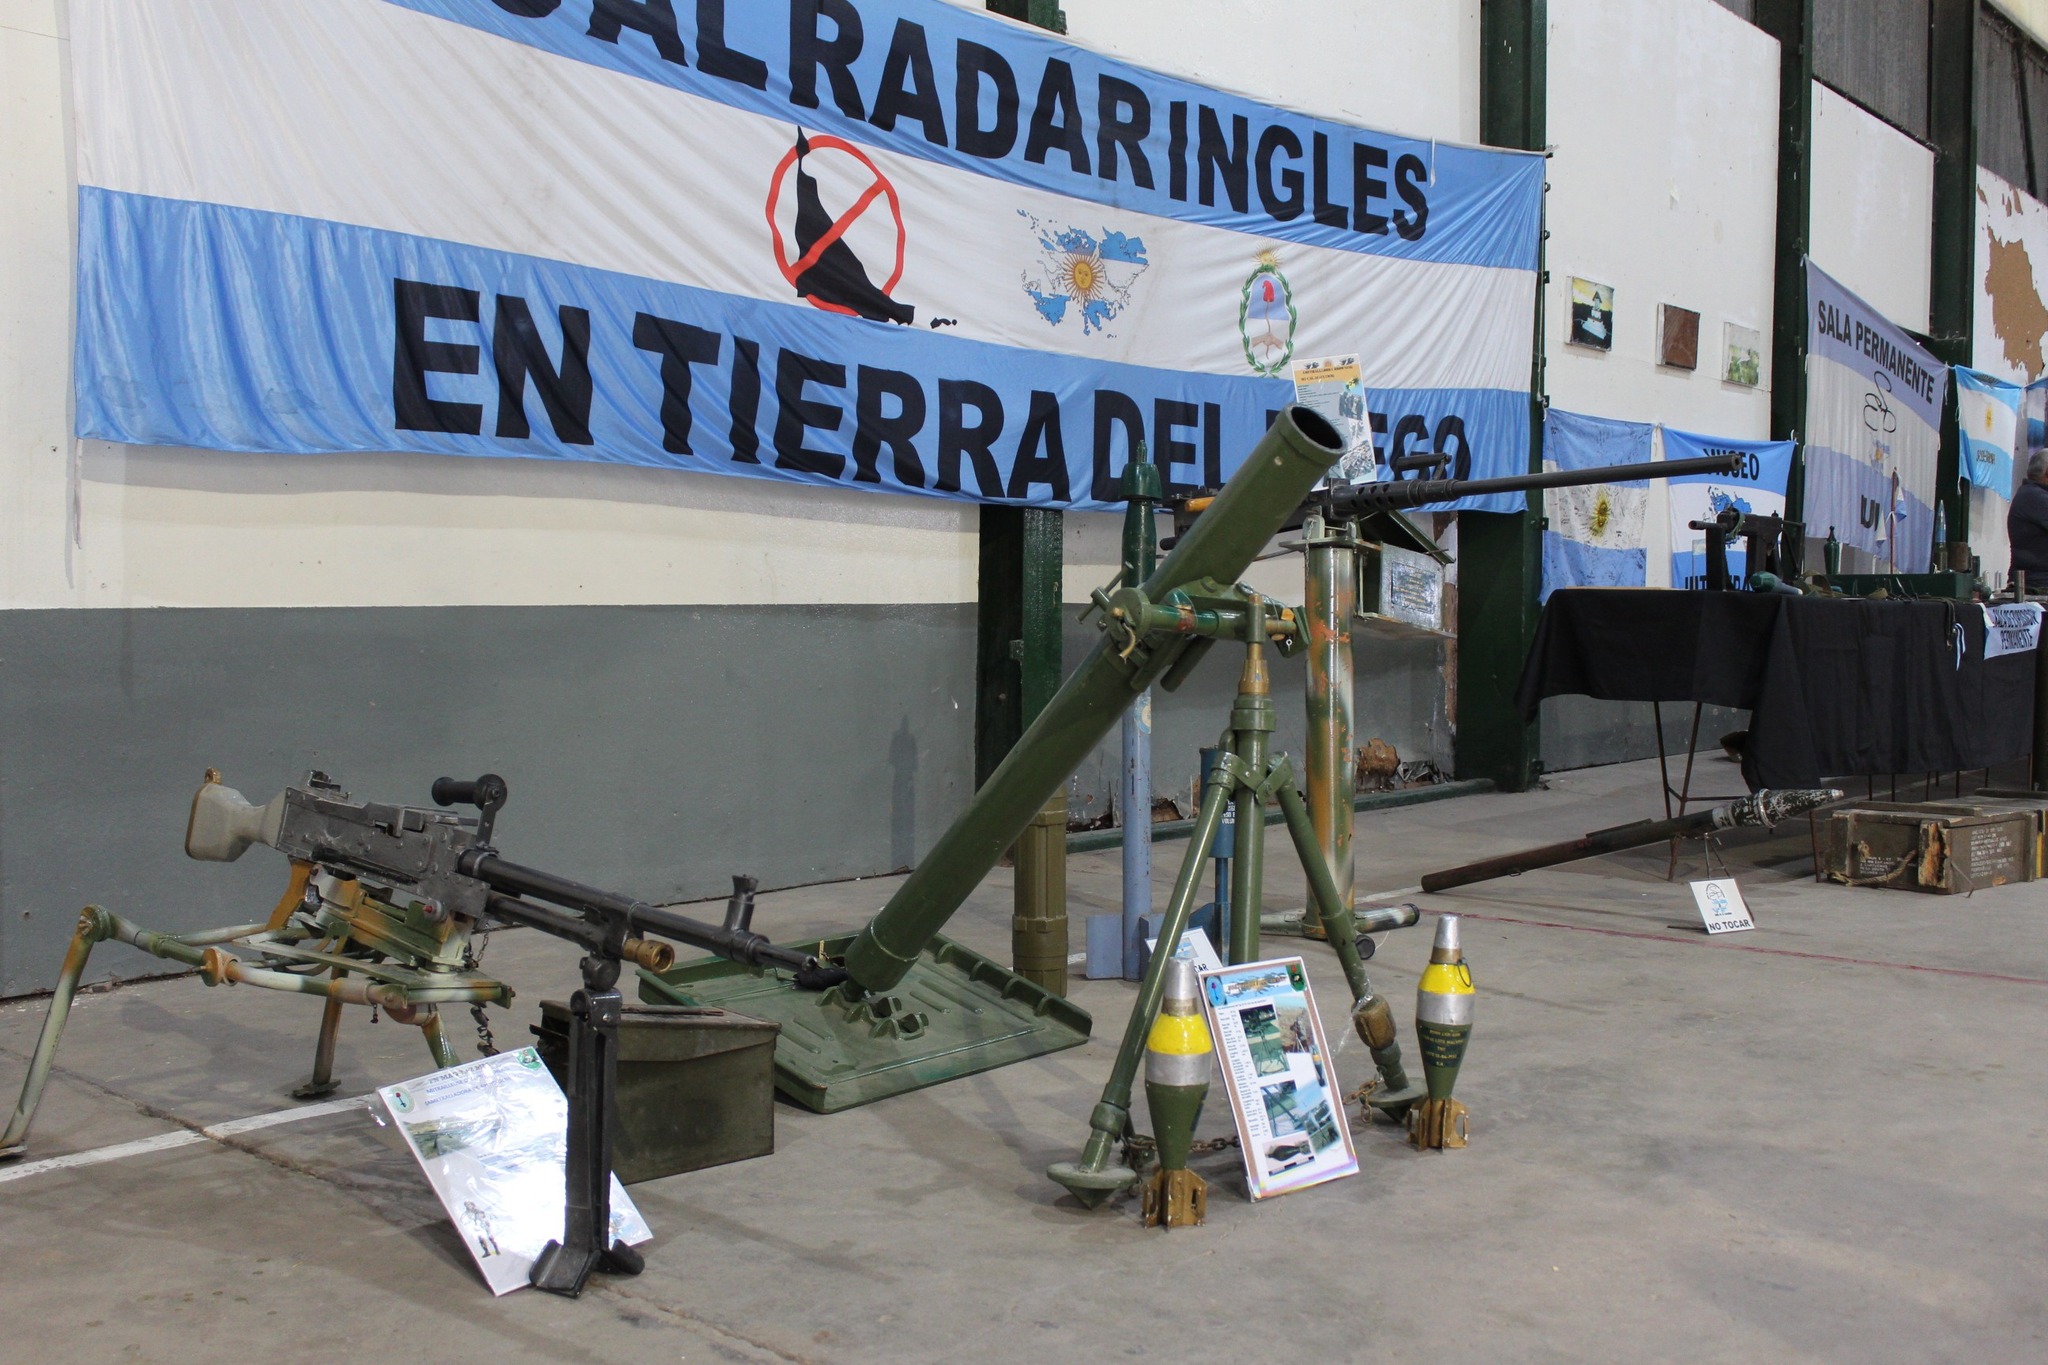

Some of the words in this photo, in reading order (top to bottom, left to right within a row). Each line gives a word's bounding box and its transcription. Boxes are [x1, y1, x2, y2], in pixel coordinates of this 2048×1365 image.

[789, 0, 1156, 189] RADAR
[1168, 101, 1428, 241] INGLES
[395, 278, 594, 446] EN
[633, 311, 1072, 502] TIERRA
[1818, 300, 1851, 347] SALA
[1856, 320, 1935, 405] PERMANENTE
[1709, 922, 1722, 931] NO
[1722, 919, 1751, 930] TOCAR
